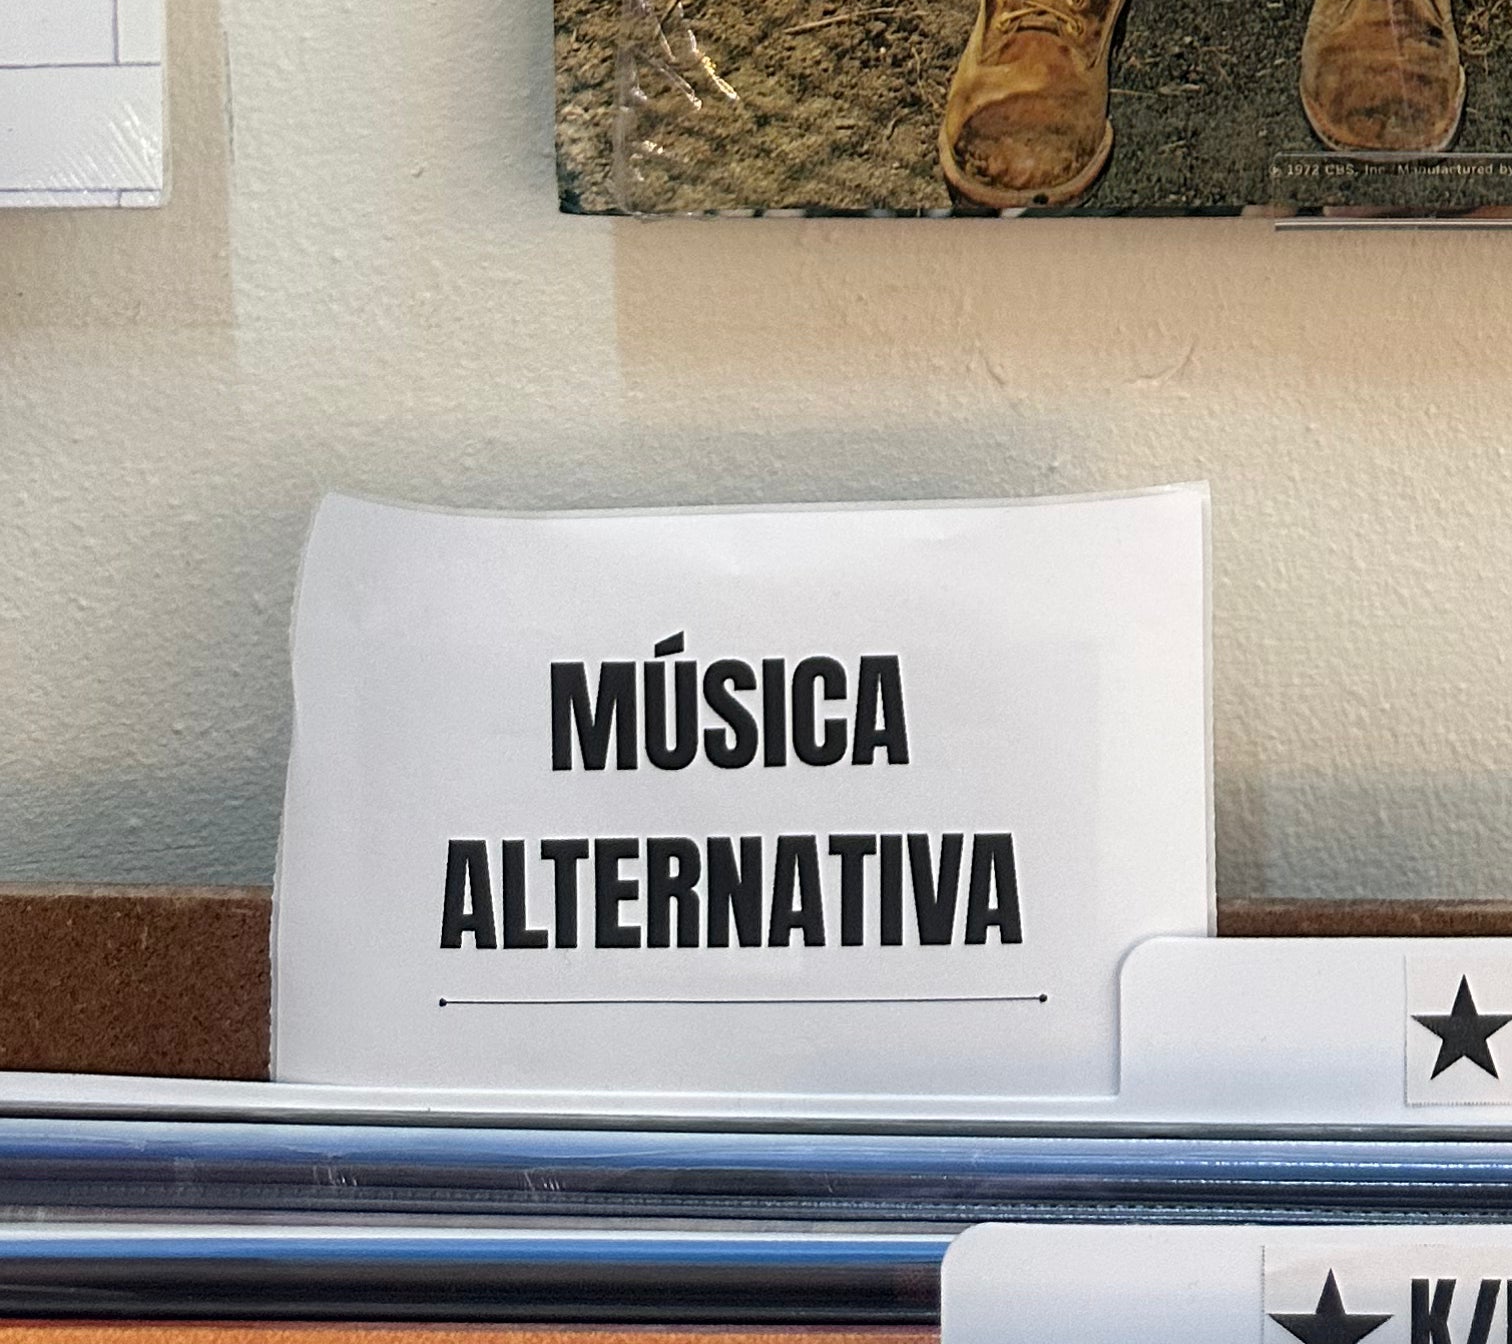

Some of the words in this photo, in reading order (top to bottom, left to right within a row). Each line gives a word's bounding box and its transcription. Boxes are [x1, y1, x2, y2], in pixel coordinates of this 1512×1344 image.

[1287, 163, 1320, 176] 1972
[1325, 163, 1359, 177] CBS,
[549, 630, 910, 772] MÚSICA
[439, 831, 1024, 950] ALTERNATIVA
